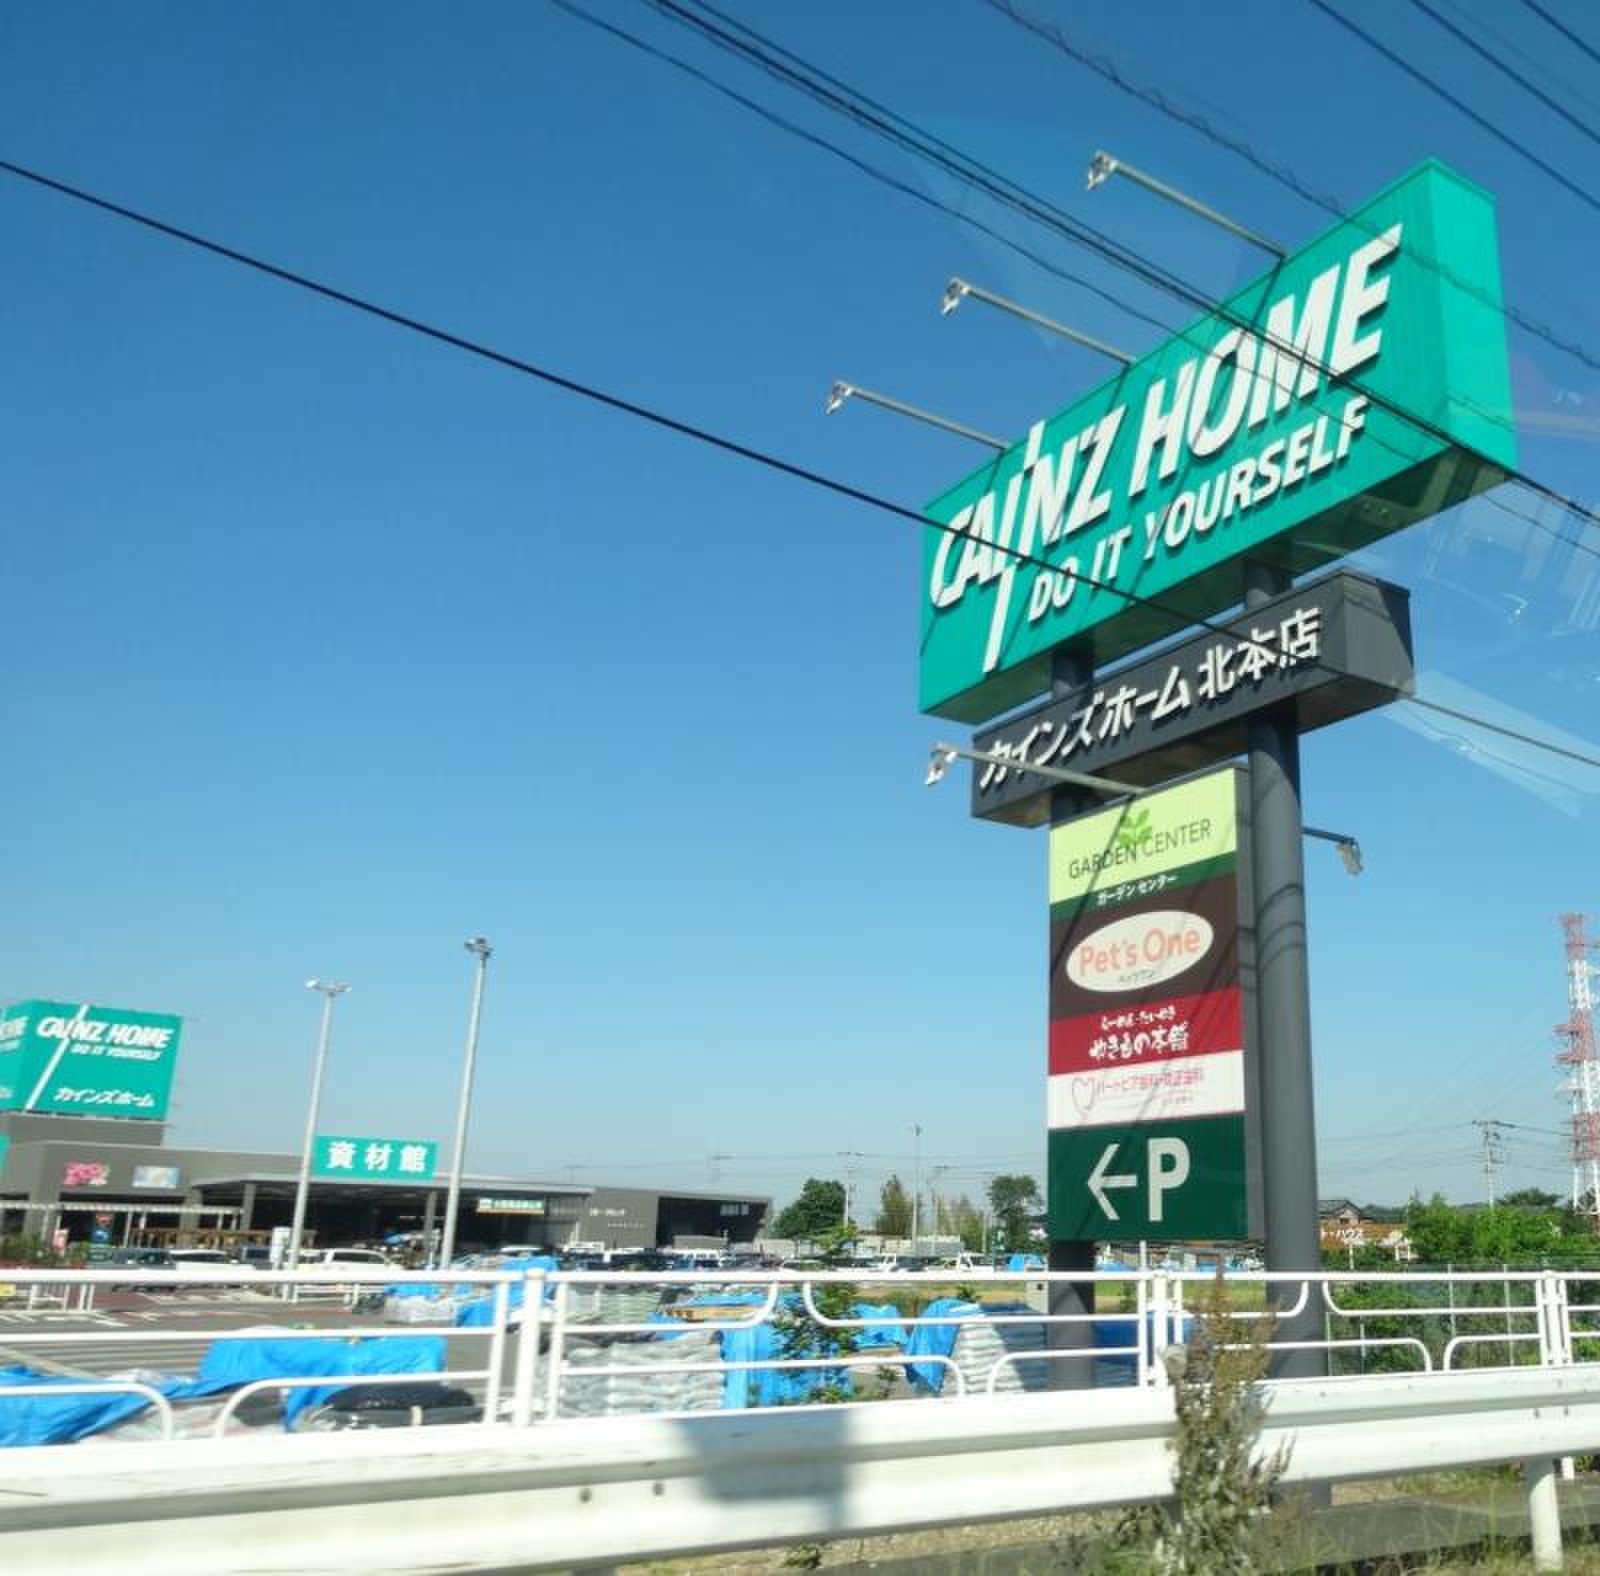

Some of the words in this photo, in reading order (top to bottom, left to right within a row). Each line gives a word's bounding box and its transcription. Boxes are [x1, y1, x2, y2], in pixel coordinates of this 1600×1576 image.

[930, 405, 1126, 673] CAINZ
[1130, 224, 1403, 498] HOME
[1028, 557, 1076, 624] DO
[1090, 523, 1132, 590] IT
[1145, 396, 1369, 561] YOURSELF
[980, 666, 1192, 789] カインズホーム
[1198, 607, 1321, 700] 北本店
[1069, 842, 1137, 880] GARDEN
[1143, 818, 1212, 857] CENTER
[1078, 939, 1137, 976] Pet's
[1144, 927, 1200, 962] One
[106, 1024, 174, 1049] HOME
[54, 1087, 155, 1107] カインズホーム
[326, 1141, 427, 1172] 資材館
[1148, 1137, 1190, 1222] P
